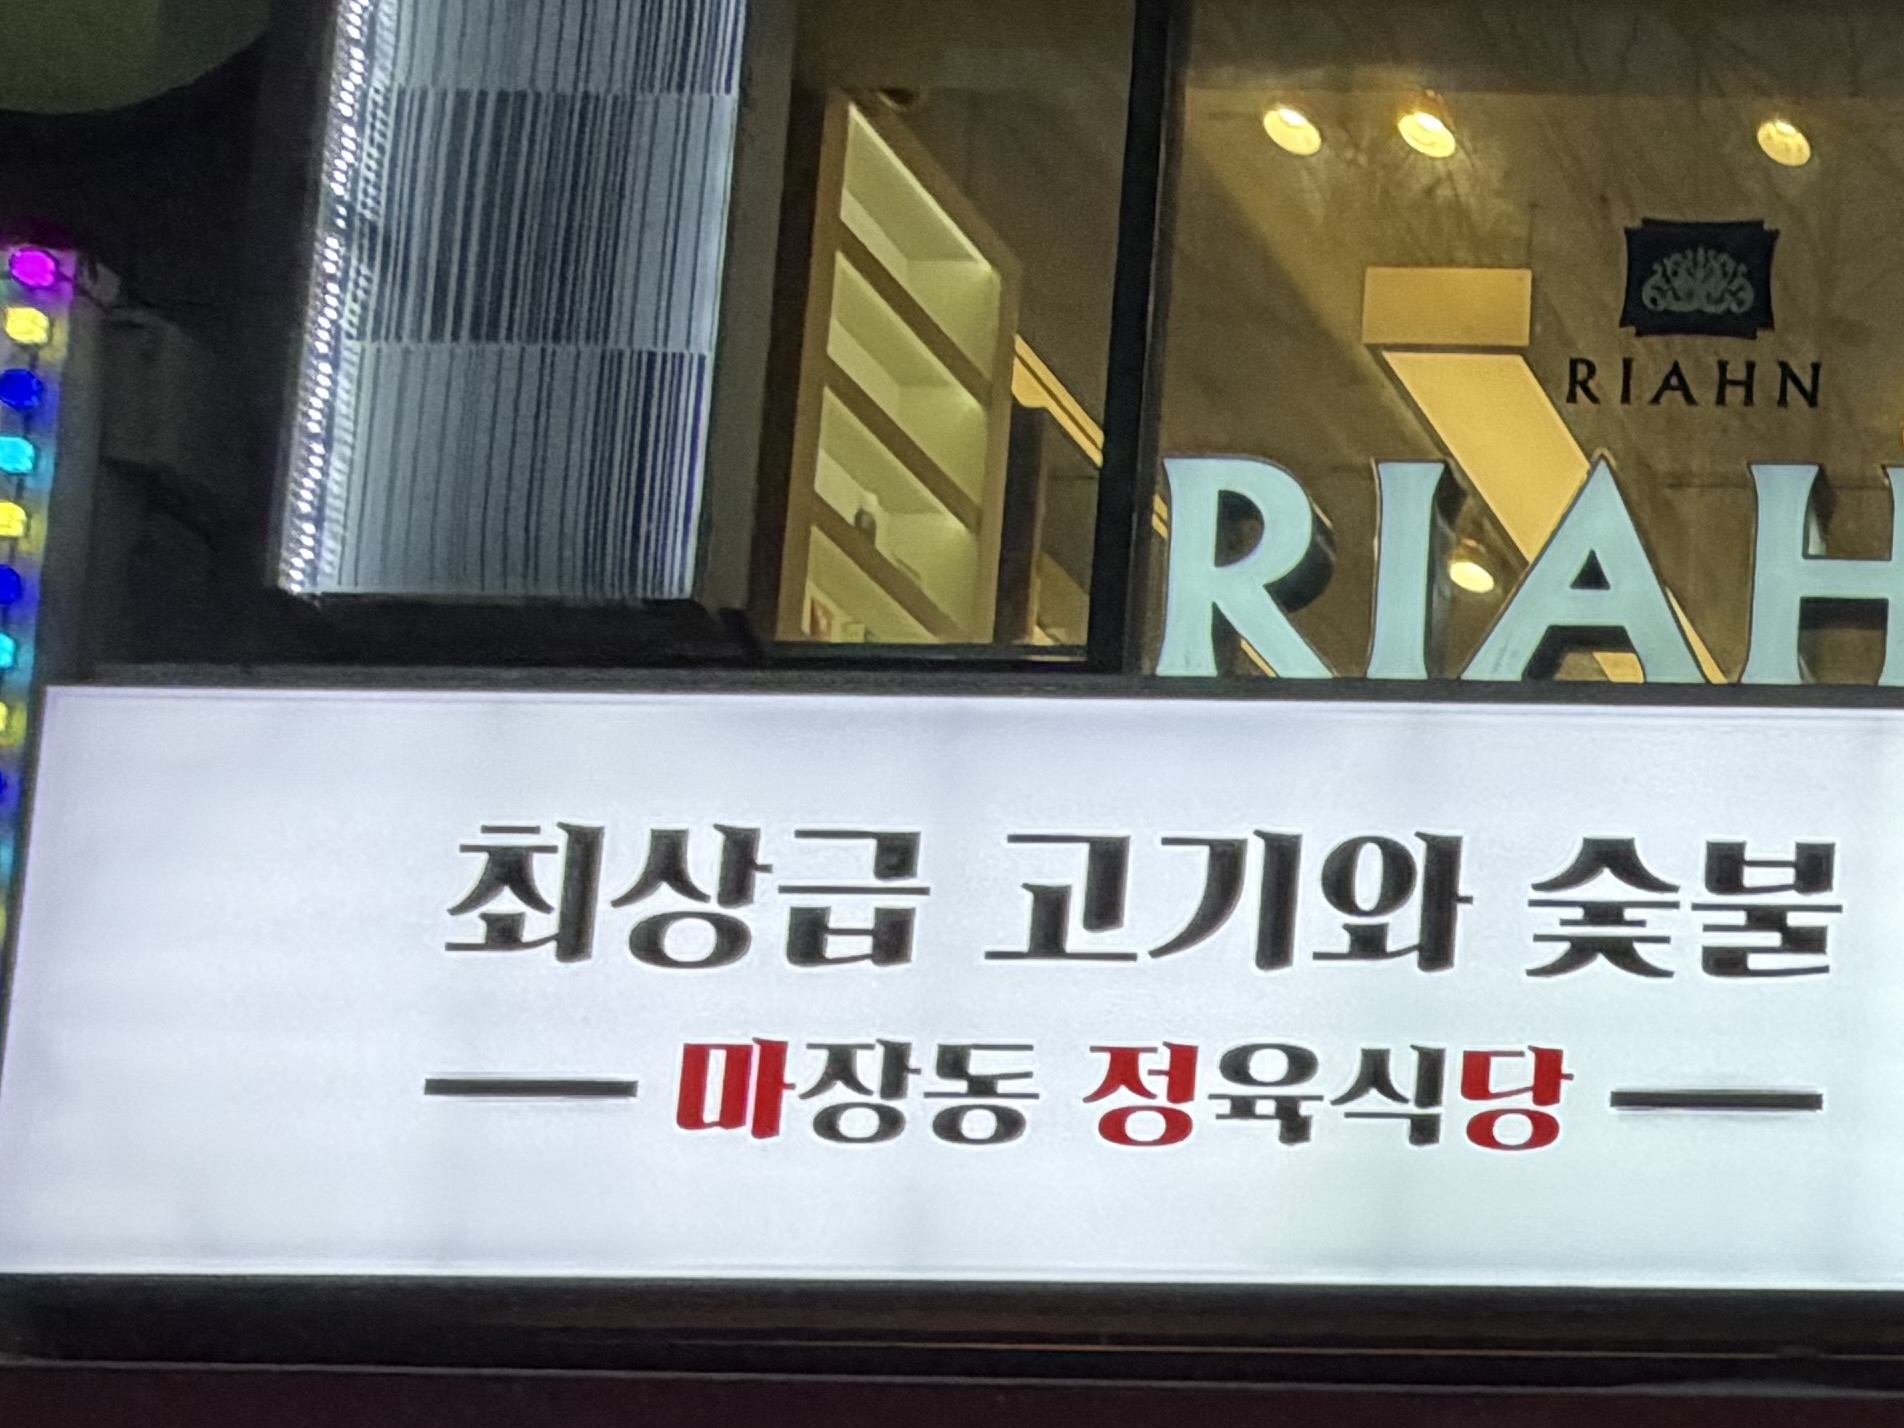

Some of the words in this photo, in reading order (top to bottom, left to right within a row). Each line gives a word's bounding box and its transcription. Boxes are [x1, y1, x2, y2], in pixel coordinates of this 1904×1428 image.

[1564, 357, 1822, 408] RIAHN
[443, 819, 931, 969] 최상급
[984, 827, 1472, 973] 고기와
[1525, 834, 1844, 979] 숯불
[676, 1035, 1040, 1146] 마장동
[1081, 1038, 1573, 1151] 정육식당
